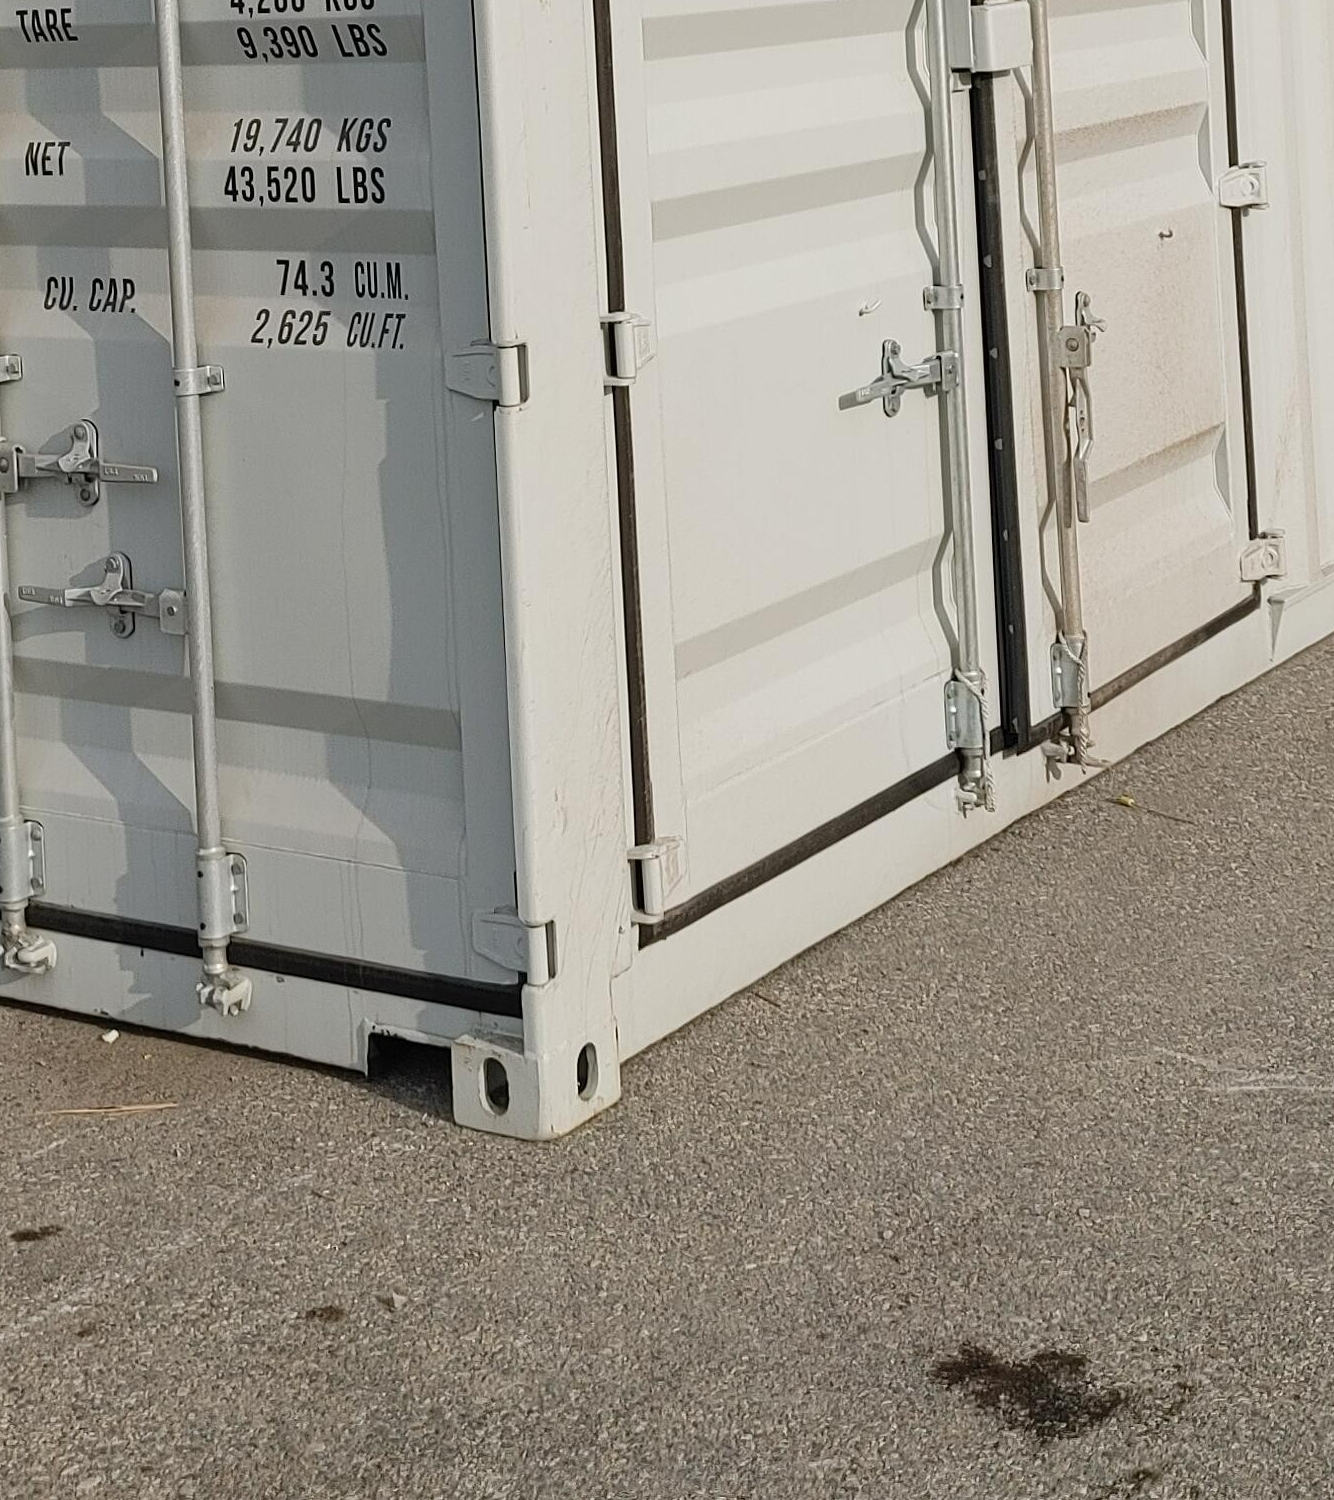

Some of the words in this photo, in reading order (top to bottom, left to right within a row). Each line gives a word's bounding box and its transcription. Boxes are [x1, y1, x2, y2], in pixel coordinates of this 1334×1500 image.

[15, 7, 79, 44] TARE
[236, 25, 319, 63] 9,390
[330, 23, 388, 58] LBS
[230, 118, 322, 157] 19,740
[336, 117, 392, 153] KGS
[25, 141, 71, 177] NET
[224, 165, 316, 207] 43,520
[336, 166, 386, 205] LBS
[43, 276, 78, 312] CU.
[88, 277, 136, 314] CAP.
[276, 259, 335, 298] 74.3
[354, 260, 409, 301] CU.M.
[250, 308, 332, 349] 2,625
[346, 311, 407, 350] CU.FT.
